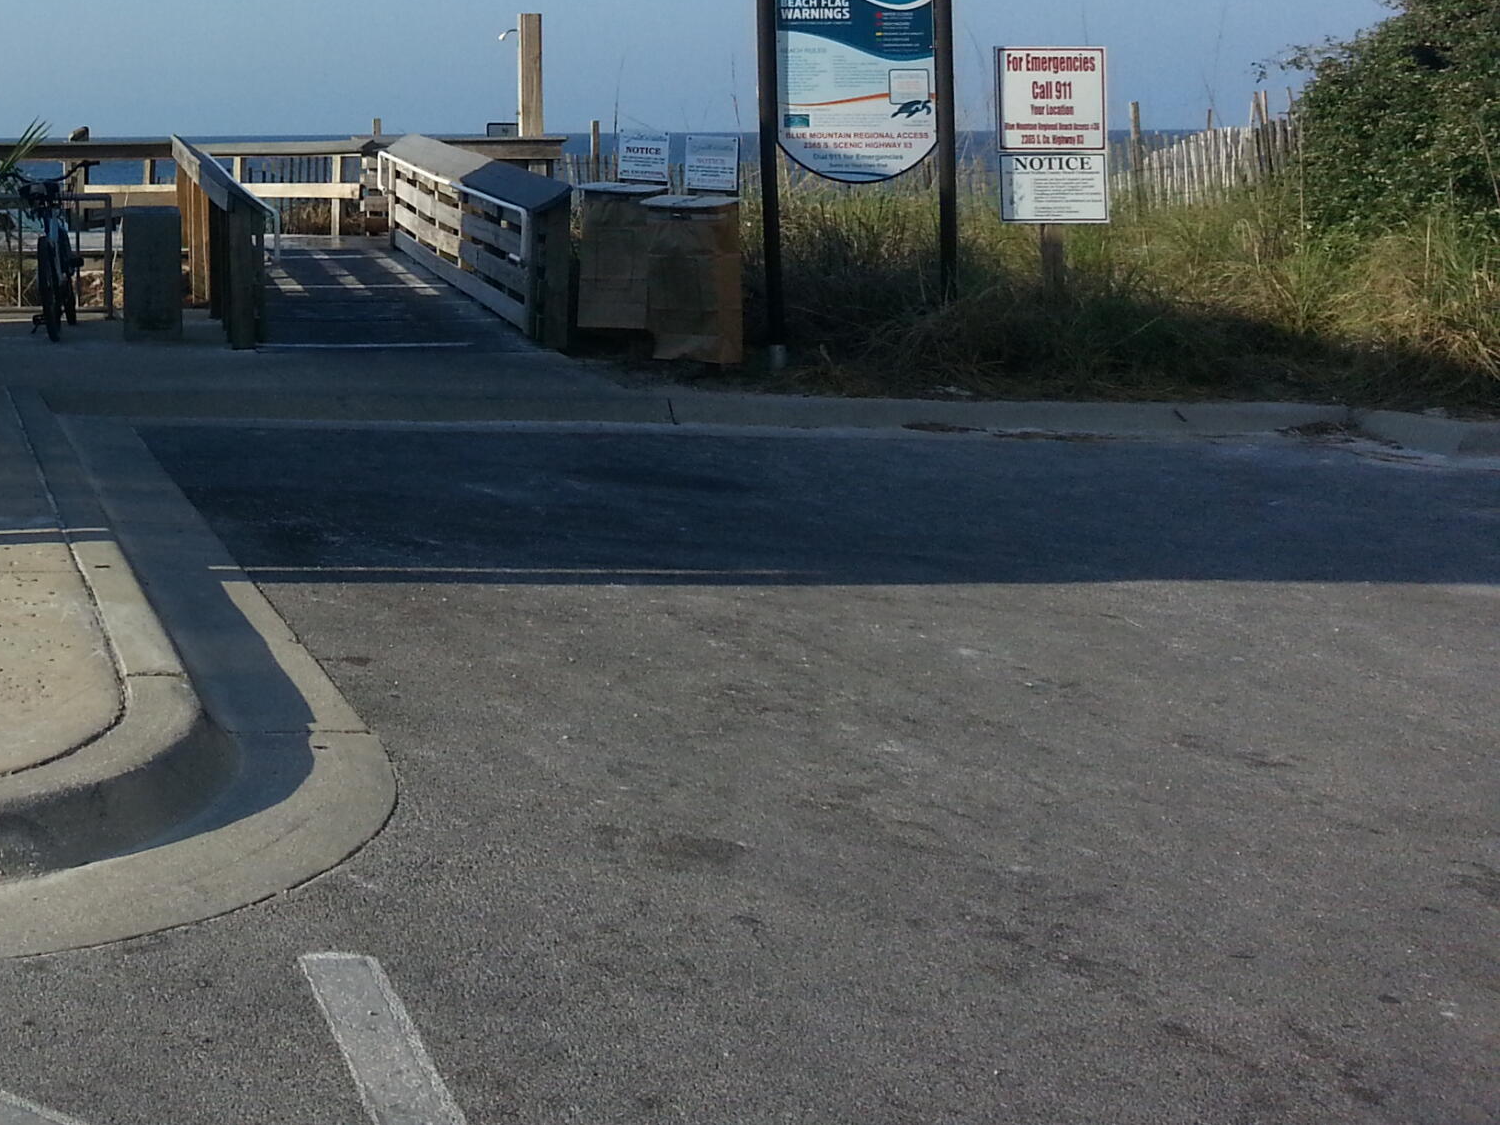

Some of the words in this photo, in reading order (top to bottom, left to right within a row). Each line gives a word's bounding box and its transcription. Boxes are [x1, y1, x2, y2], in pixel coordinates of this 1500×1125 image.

[780, 8, 851, 20] WARNINGS
[1006, 53, 1023, 72] For
[1025, 53, 1096, 74] Emergencies
[1031, 80, 1053, 100] Call
[1055, 80, 1072, 100] 911
[1046, 104, 1074, 116] Location
[785, 132, 807, 140] BLUE
[809, 132, 851, 140] MOUNTAIN
[853, 132, 895, 140] REGIONAL
[896, 132, 929, 140] ACCESS
[625, 146, 662, 155] NOTICE
[856, 153, 904, 161] Emergencies
[1014, 157, 1092, 170] NOTICE
